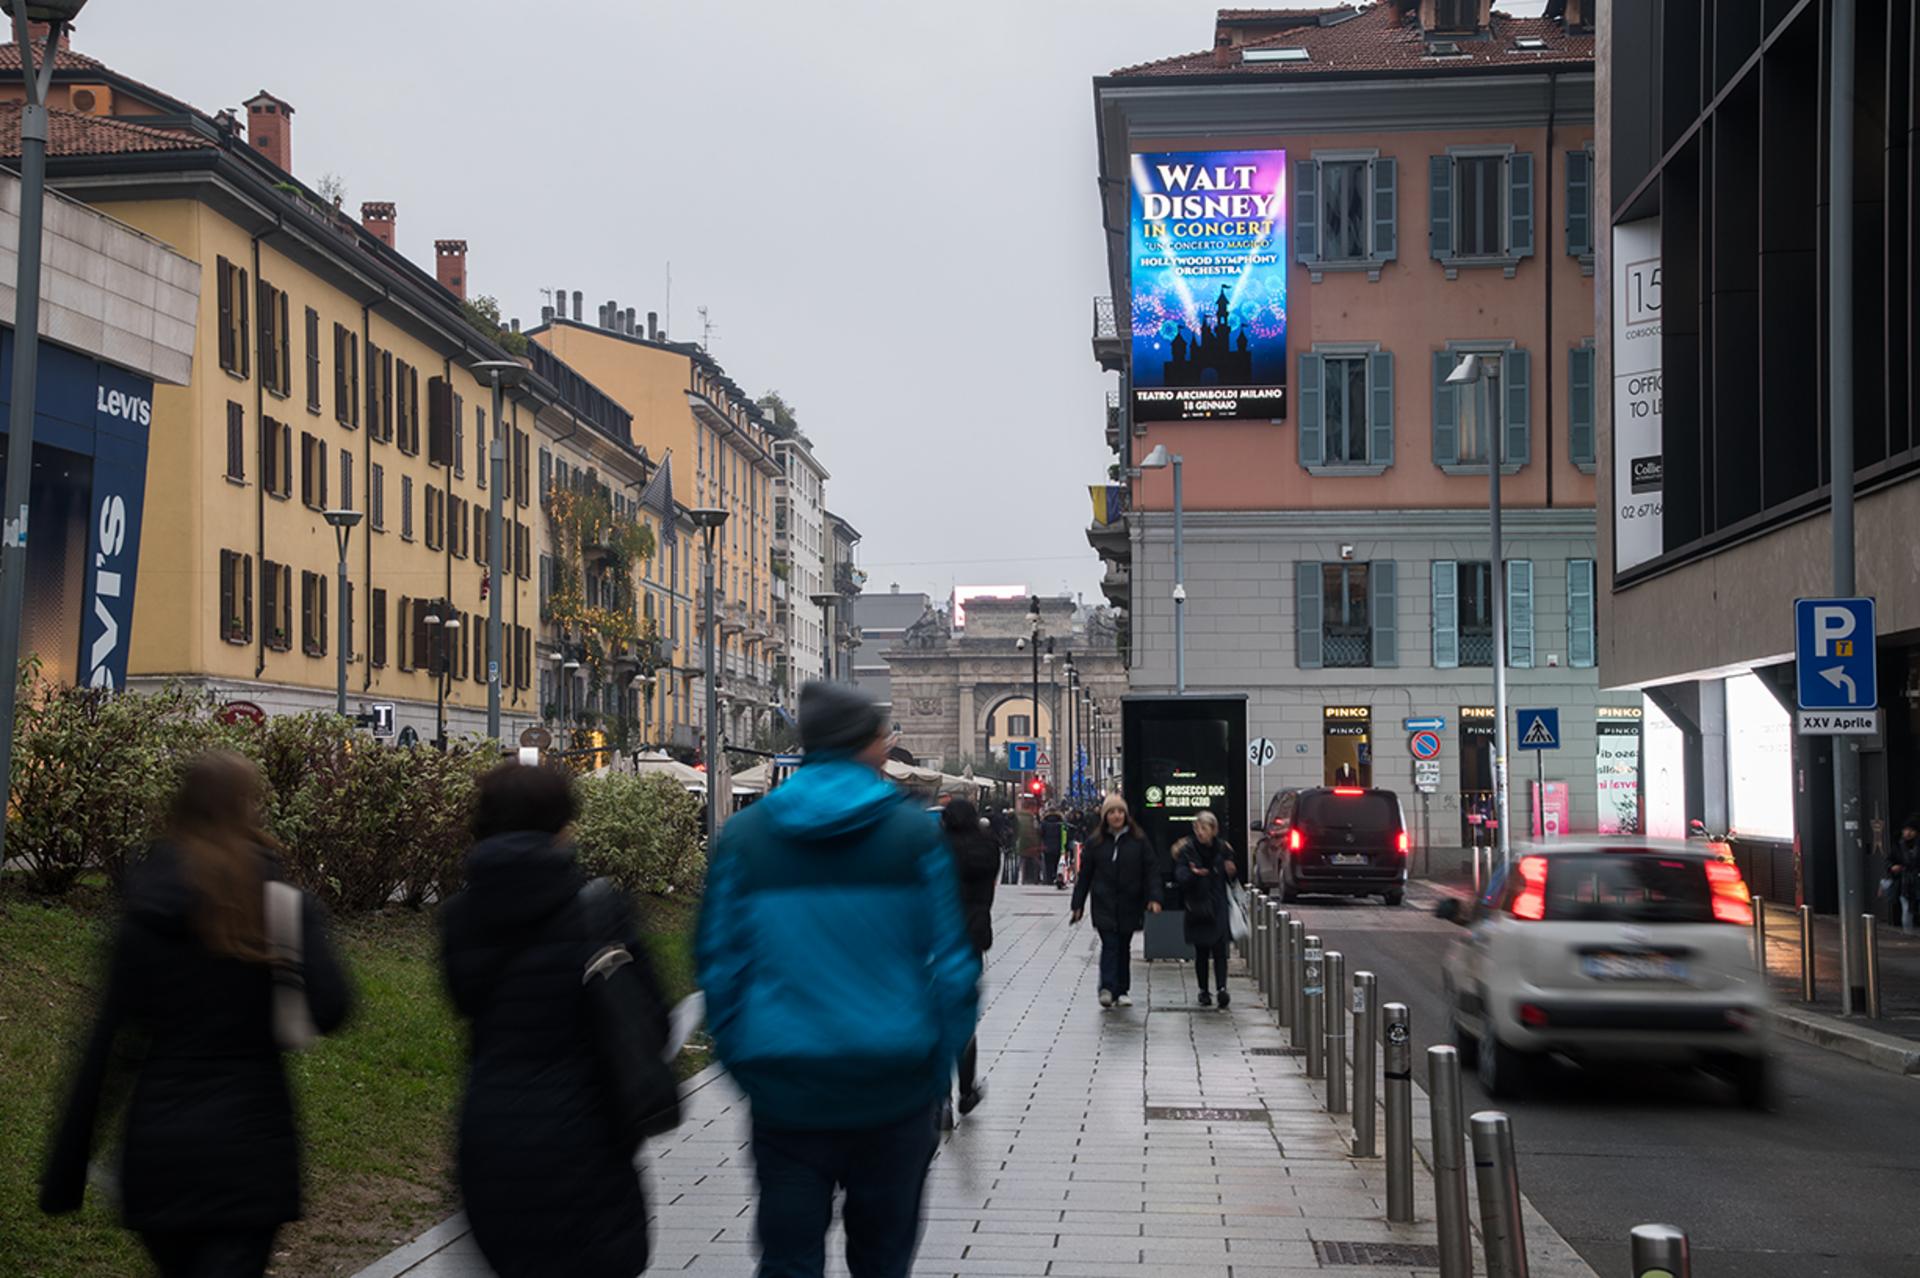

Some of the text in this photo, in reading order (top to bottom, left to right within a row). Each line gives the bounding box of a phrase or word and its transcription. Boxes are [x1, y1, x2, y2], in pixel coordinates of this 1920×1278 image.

[1157, 164, 1256, 191] WALT
[1143, 194, 1274, 220] DISNEY
[1144, 221, 1274, 237] IN CONCERT
[1141, 254, 1277, 267] HOLLYWOOD SYMPHONY
[1175, 266, 1242, 275] ORCHESTRA
[1137, 389, 1282, 400] TEATRO ARCIMBOLDI MILANO
[1183, 400, 1236, 410] 18 GENNAIO
[1629, 400, 1649, 418] TO
[1621, 505, 1635, 519] 02
[1814, 606, 1856, 657] P
[1326, 708, 1368, 717] PINKO
[1461, 708, 1495, 717] PINK
[1598, 708, 1641, 717] PINKO
[1803, 717, 1872, 729] XXV Aprile
[1165, 786, 1225, 796] PROSECCO DOC
